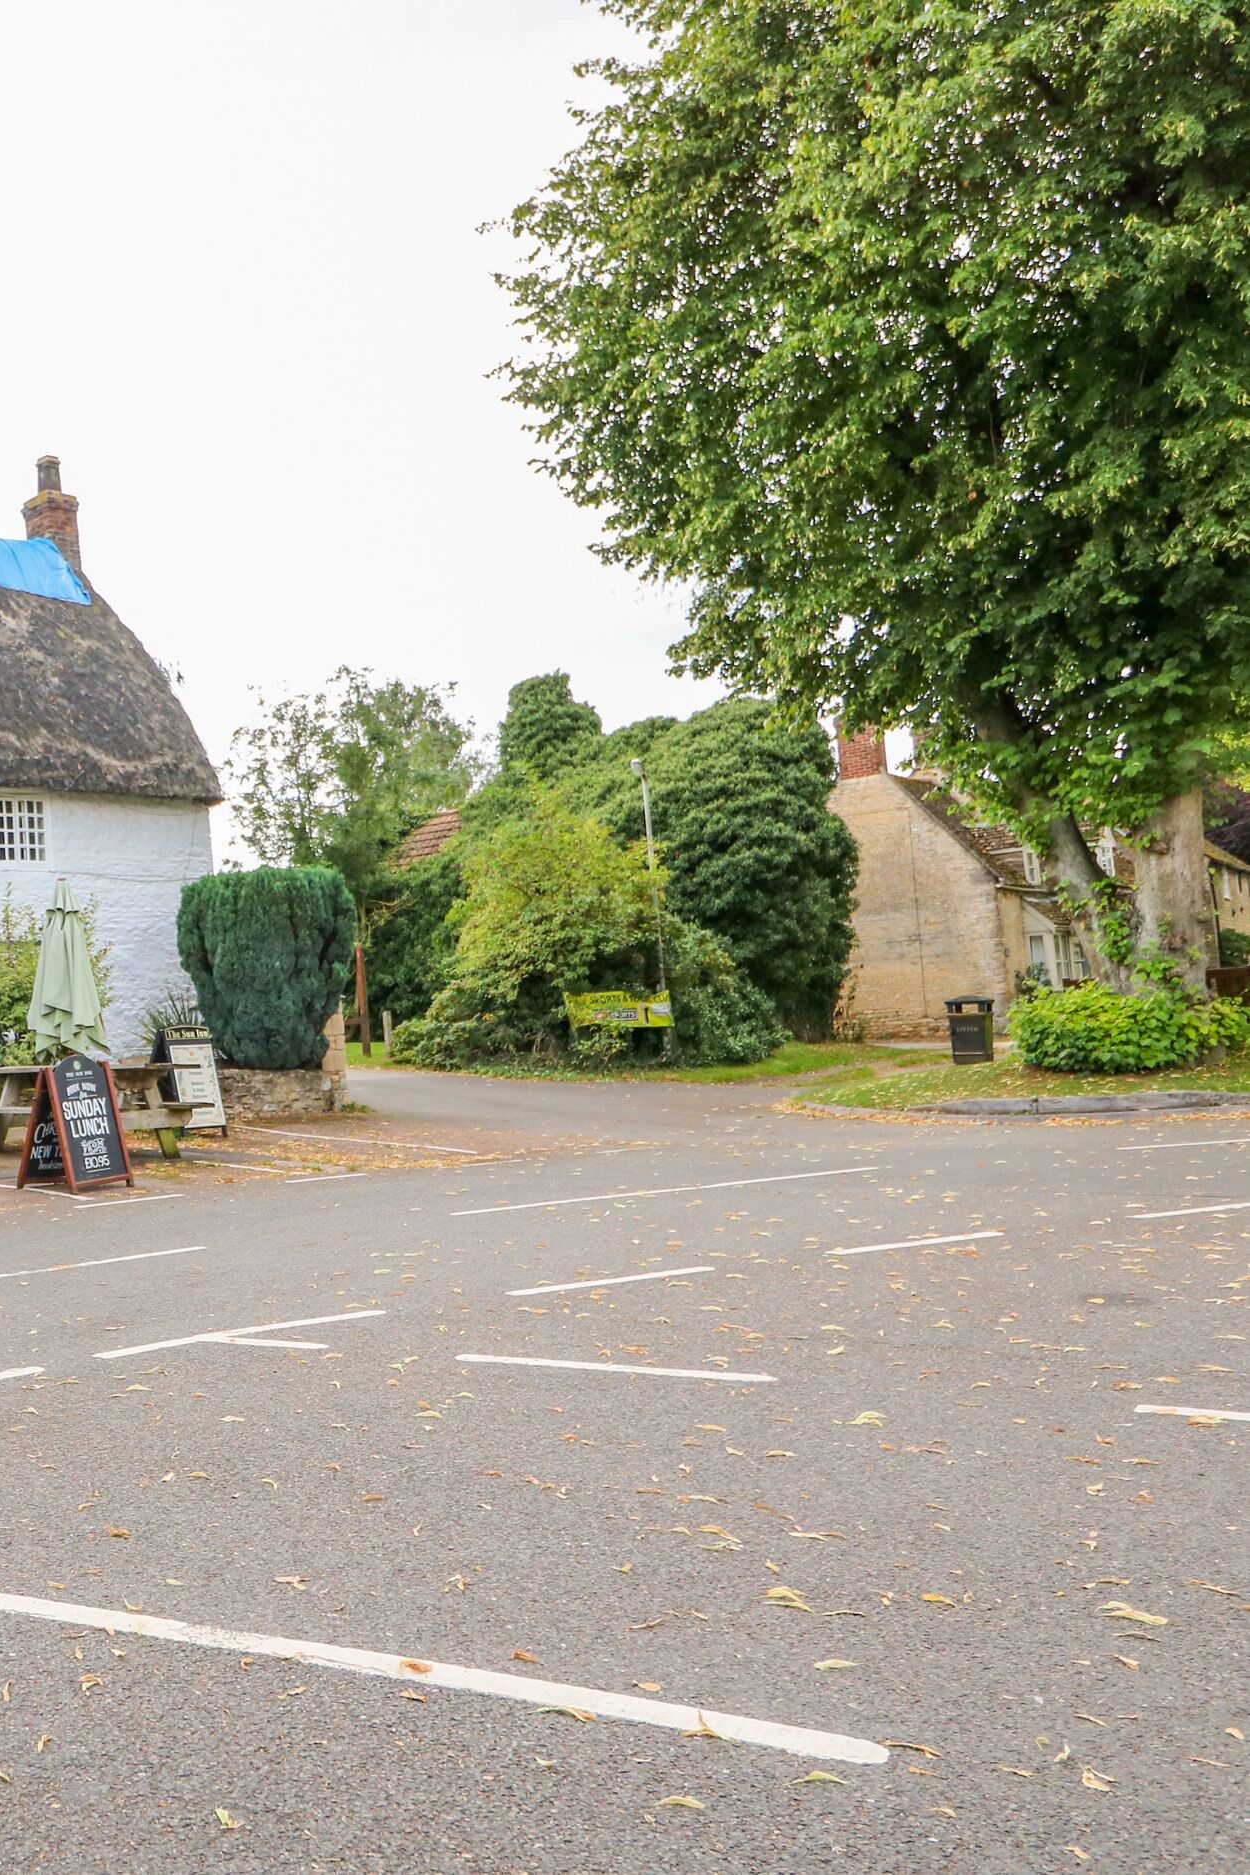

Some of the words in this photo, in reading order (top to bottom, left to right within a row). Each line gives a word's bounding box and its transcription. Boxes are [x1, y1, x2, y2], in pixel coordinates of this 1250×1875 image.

[167, 1029, 181, 1039] The
[181, 1029, 195, 1039] Sun
[195, 1029, 209, 1039] Inn
[61, 1097, 107, 1121] SUNDAY
[70, 1116, 110, 1138] LUNCH
[30, 1145, 53, 1160] NEW
